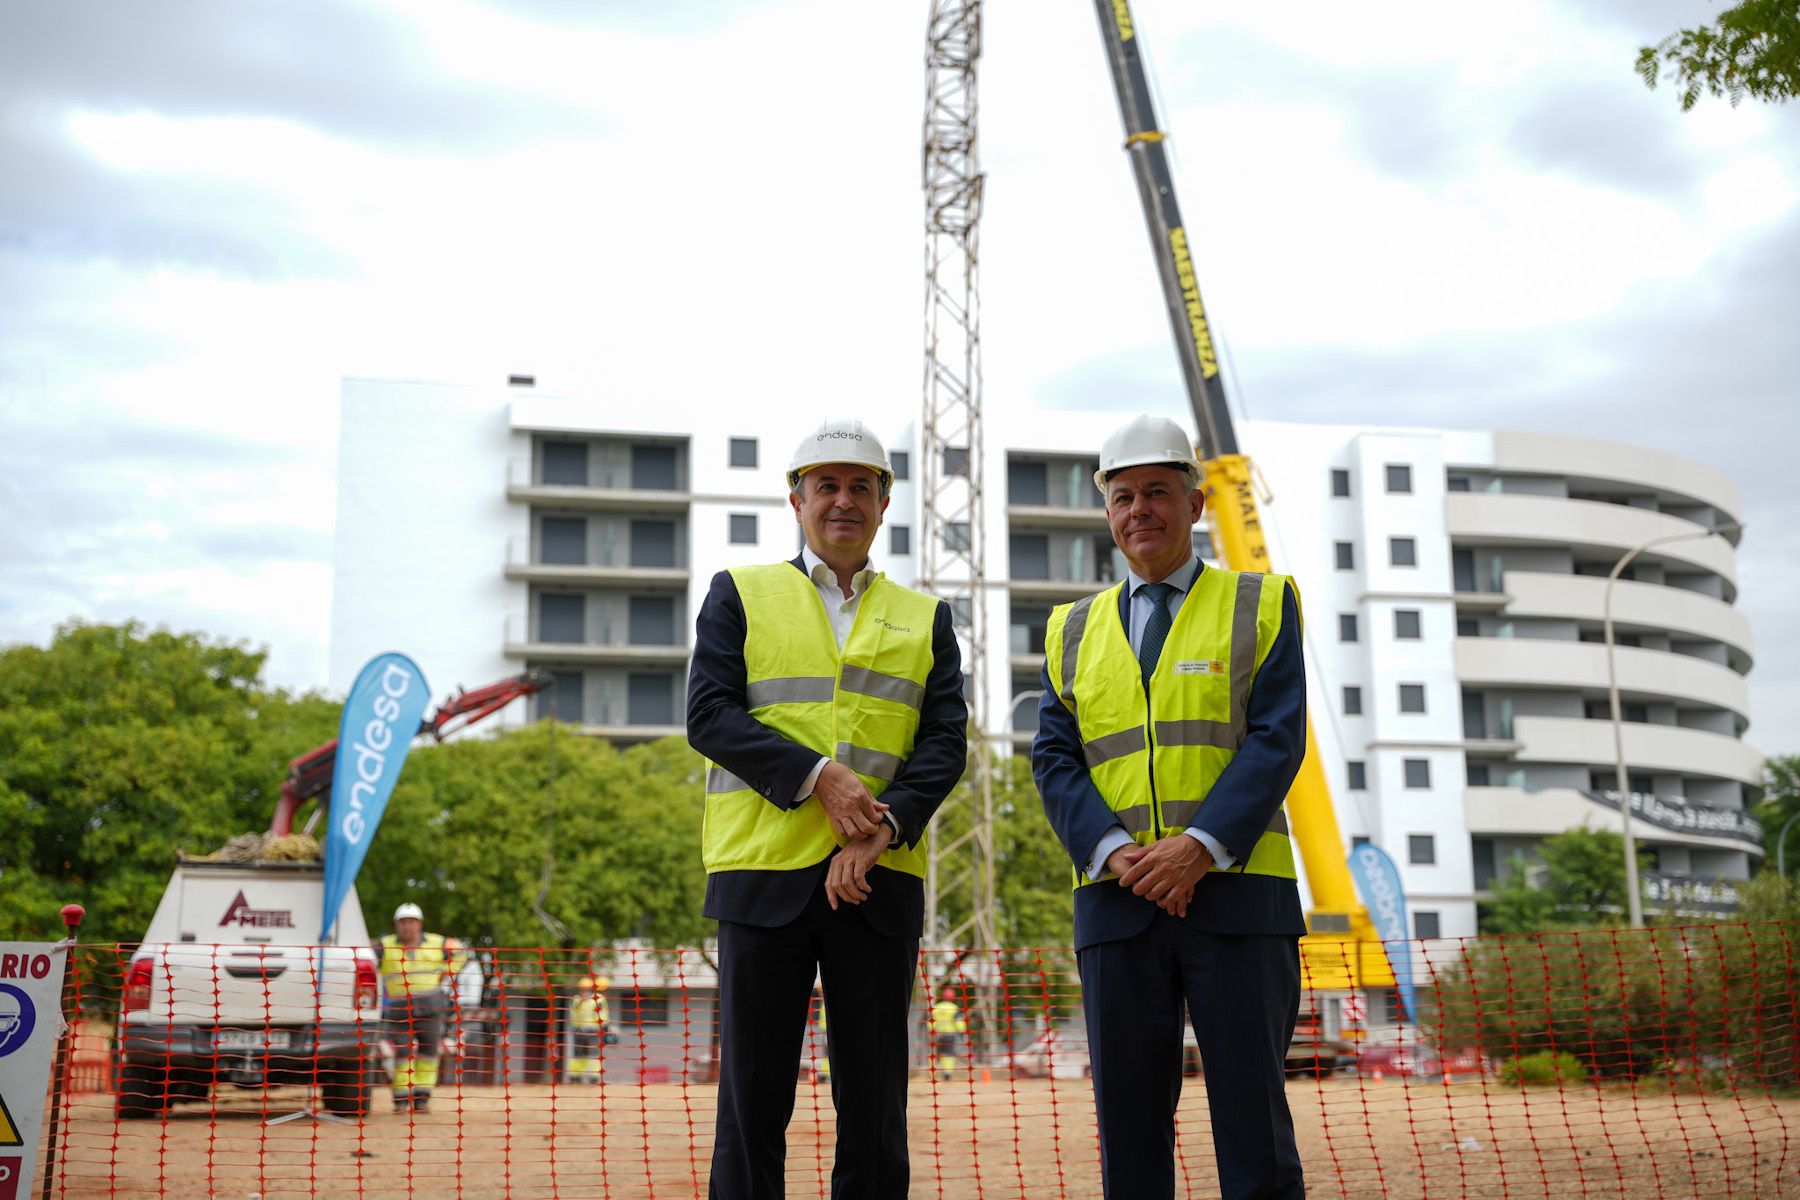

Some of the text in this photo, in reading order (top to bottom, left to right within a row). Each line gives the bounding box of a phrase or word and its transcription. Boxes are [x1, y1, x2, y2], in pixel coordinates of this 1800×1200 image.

[1169, 226, 1219, 379] MAESTRANZA
[817, 430, 863, 441] endesa
[342, 662, 411, 845] endesa
[0, 953, 51, 980] RIO
